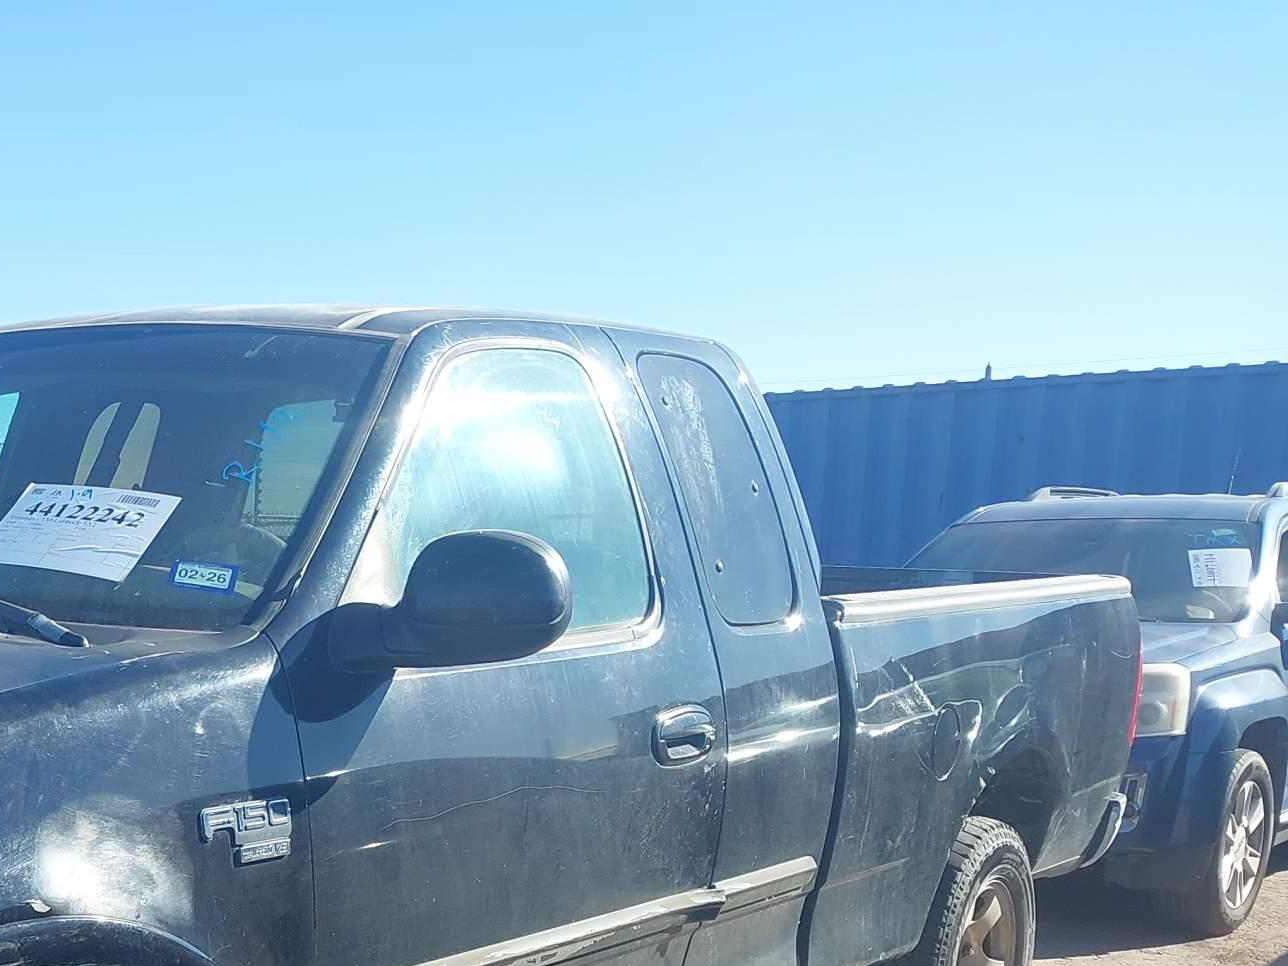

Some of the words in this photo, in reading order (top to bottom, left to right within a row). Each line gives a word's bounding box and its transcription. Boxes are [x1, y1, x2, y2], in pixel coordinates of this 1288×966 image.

[24, 500, 147, 529] 44122242
[178, 568, 199, 580] 02
[206, 571, 227, 584] 26
